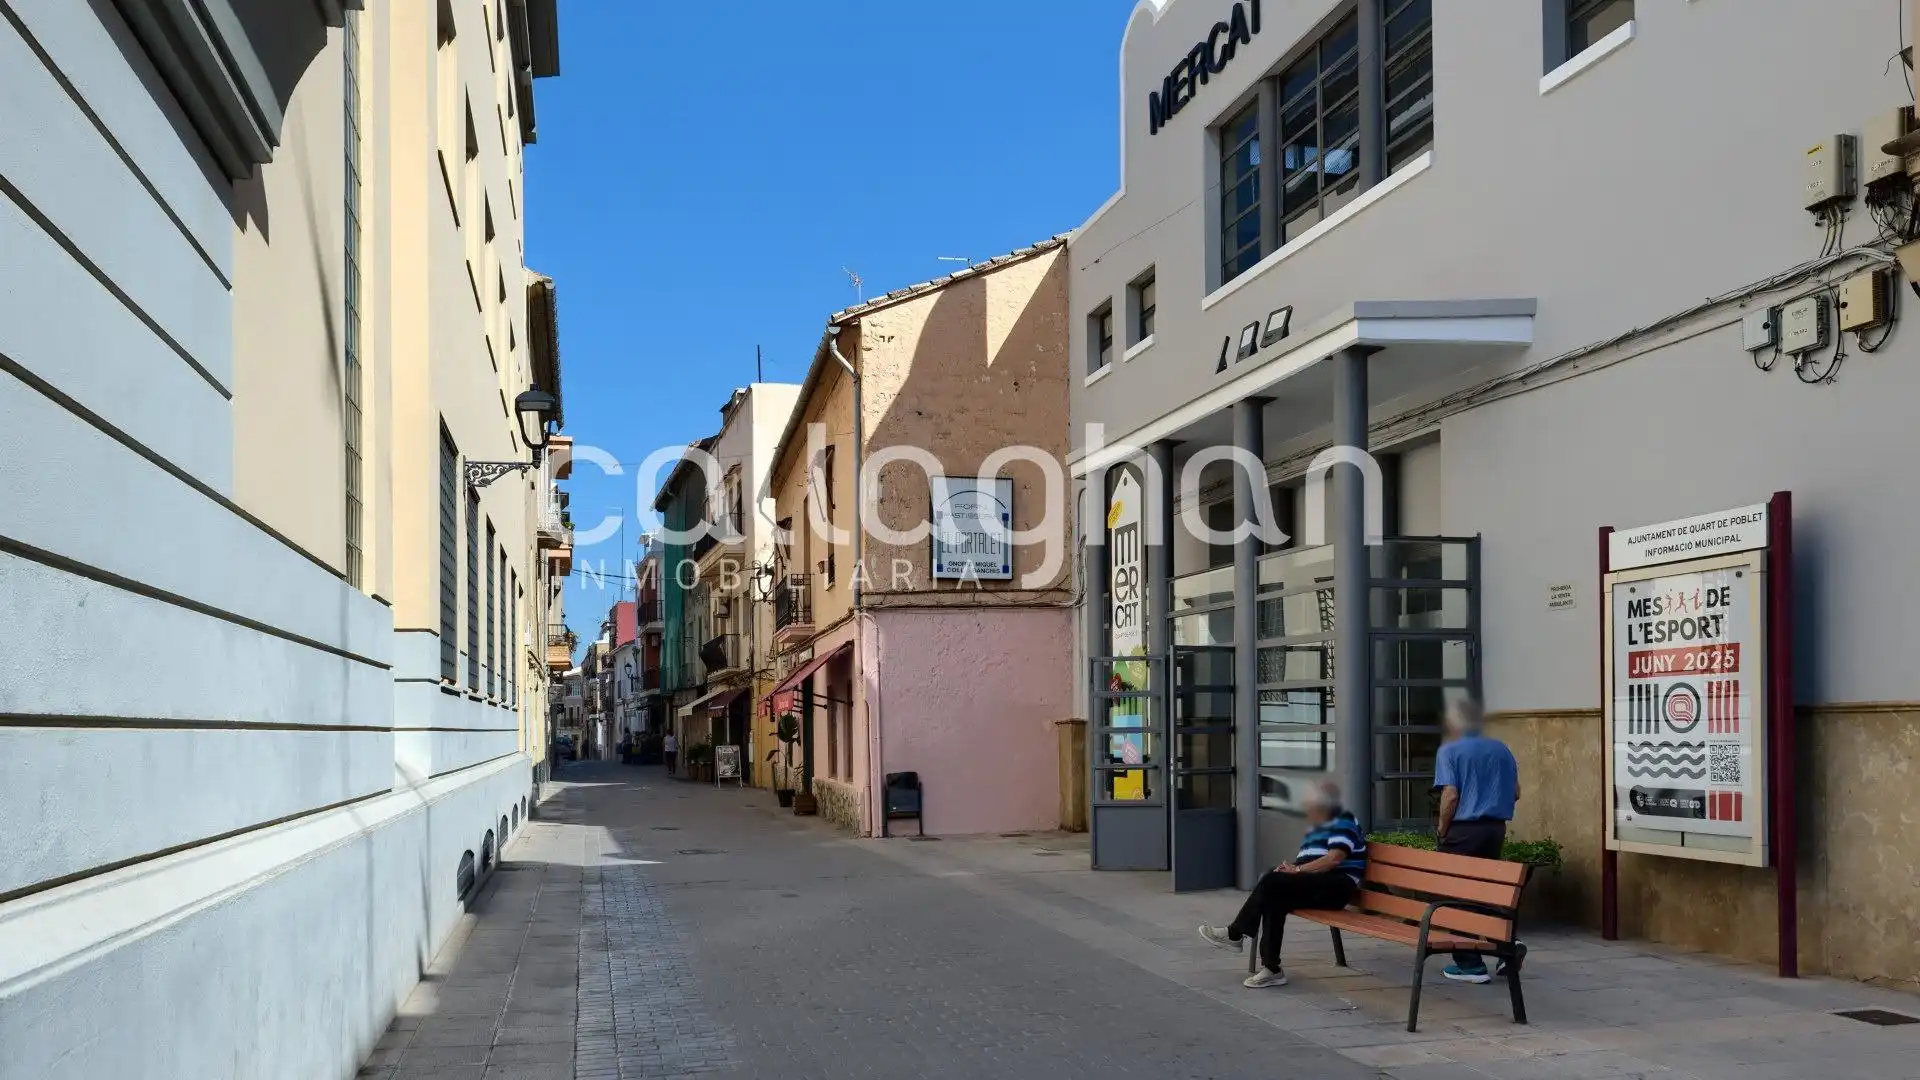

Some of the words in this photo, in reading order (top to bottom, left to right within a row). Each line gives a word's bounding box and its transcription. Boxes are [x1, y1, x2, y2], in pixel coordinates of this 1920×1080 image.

[1149, 0, 1261, 135] MERCAT
[1627, 528, 1676, 546] AJUNTAMENT
[1677, 526, 1688, 536] DE
[1689, 520, 1716, 534] QUART
[1717, 518, 1728, 529] DE
[1730, 512, 1763, 526] POBLET
[1694, 533, 1741, 549] MUNICIPAL
[1627, 596, 1664, 620] MES
[1706, 585, 1731, 610] DE
[1628, 614, 1724, 646] L'ESPORT
[1632, 654, 1677, 675] JUNY
[1683, 650, 1735, 671] 2025
